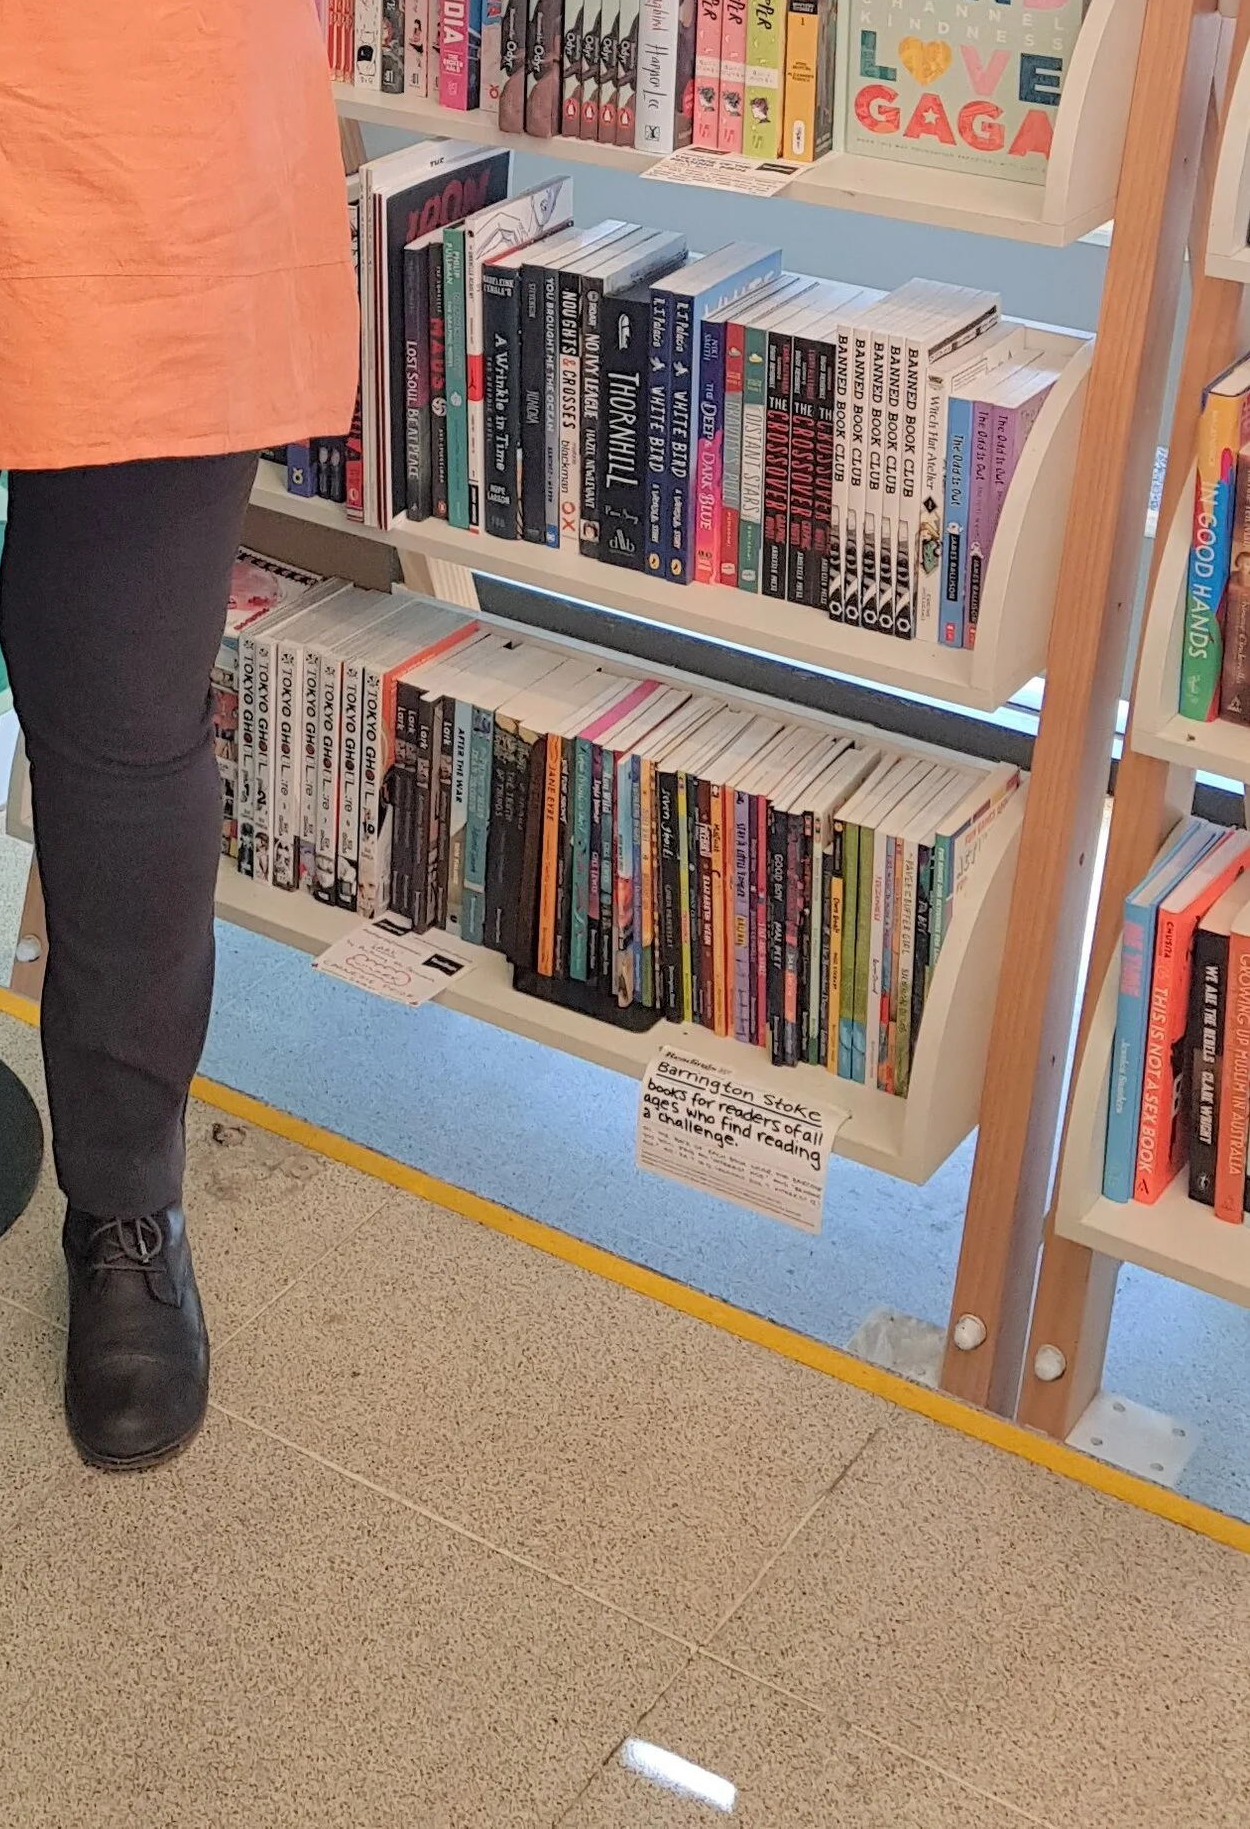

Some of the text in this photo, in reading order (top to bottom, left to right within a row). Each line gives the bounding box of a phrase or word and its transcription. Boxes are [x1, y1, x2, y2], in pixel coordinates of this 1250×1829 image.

[642, 43, 669, 88] Harper
[854, 83, 1054, 162] GAGA
[561, 289, 578, 357] NOUGHTS
[561, 369, 577, 430] CROSSES
[605, 371, 641, 489] THORNHILL
[903, 348, 919, 498] BANNED BOOK CLUB
[670, 391, 688, 479] WHITE BIRD
[1195, 511, 1218, 580] GOOD
[1188, 584, 1214, 660] HANDS
[365, 680, 379, 743] TOKYO
[643, 1108, 739, 1148] a challenge.
[644, 1094, 821, 1171] ages who find reading
[648, 1078, 823, 1146] books for readers of all
[763, 1094, 822, 1122] Stoke
